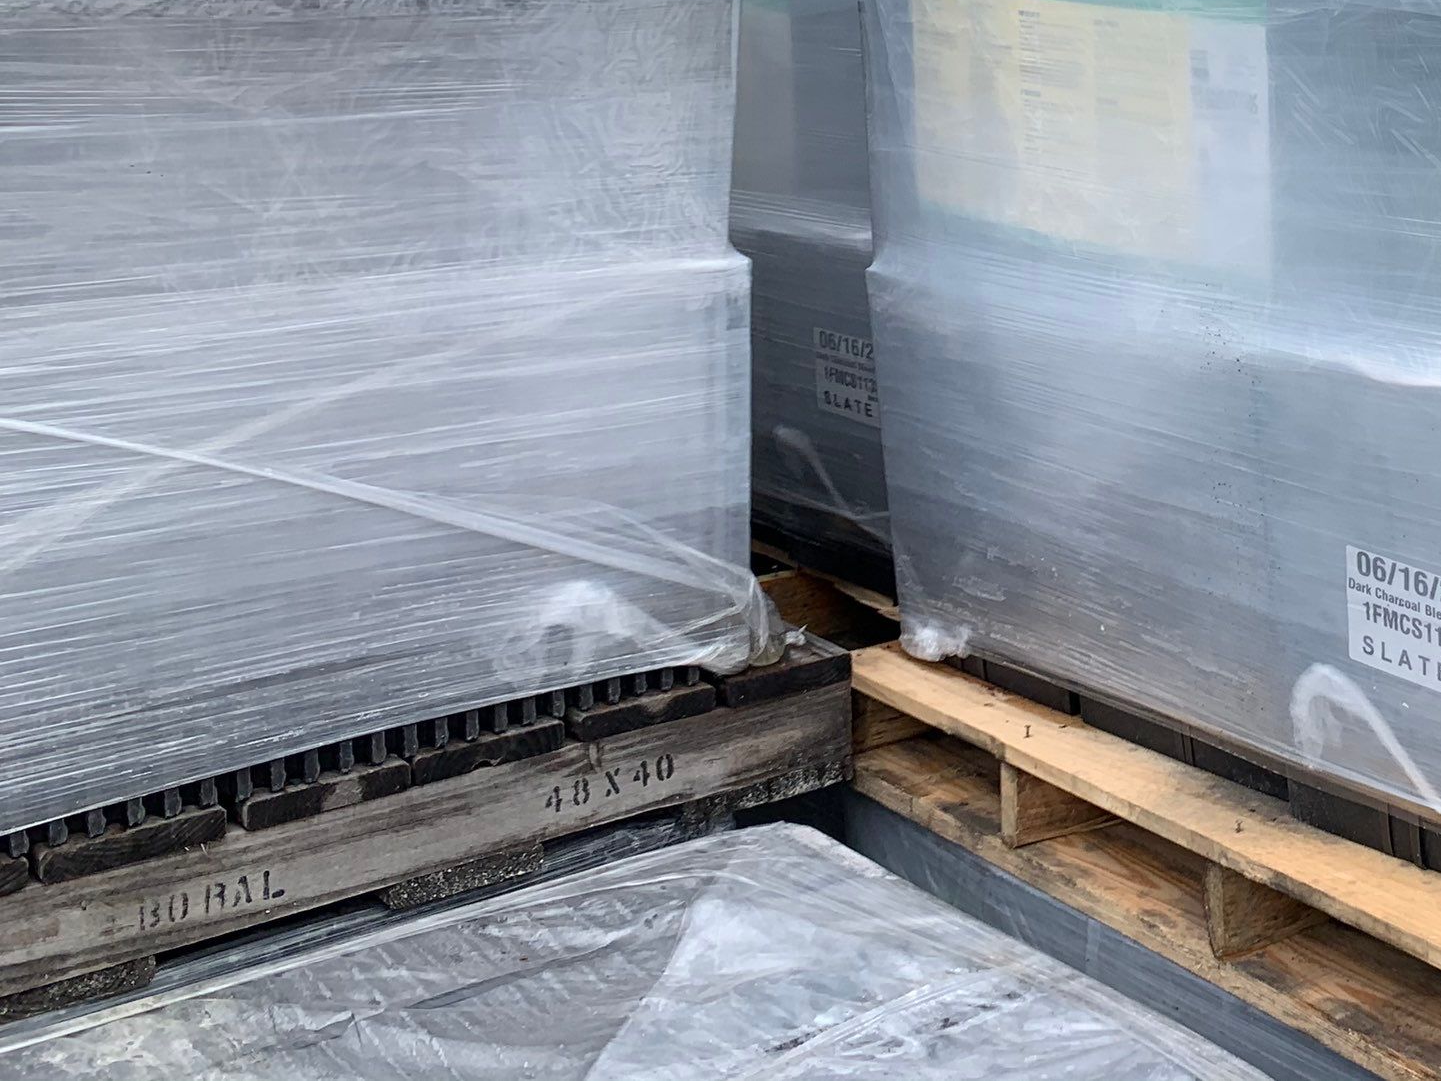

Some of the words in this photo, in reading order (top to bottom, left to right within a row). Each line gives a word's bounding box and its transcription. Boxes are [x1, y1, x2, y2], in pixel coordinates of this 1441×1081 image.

[824, 390, 873, 417] SLATE
[1348, 577, 1372, 595] Dark
[1375, 587, 1420, 613] Charcoal
[138, 869, 286, 931] BORAL
